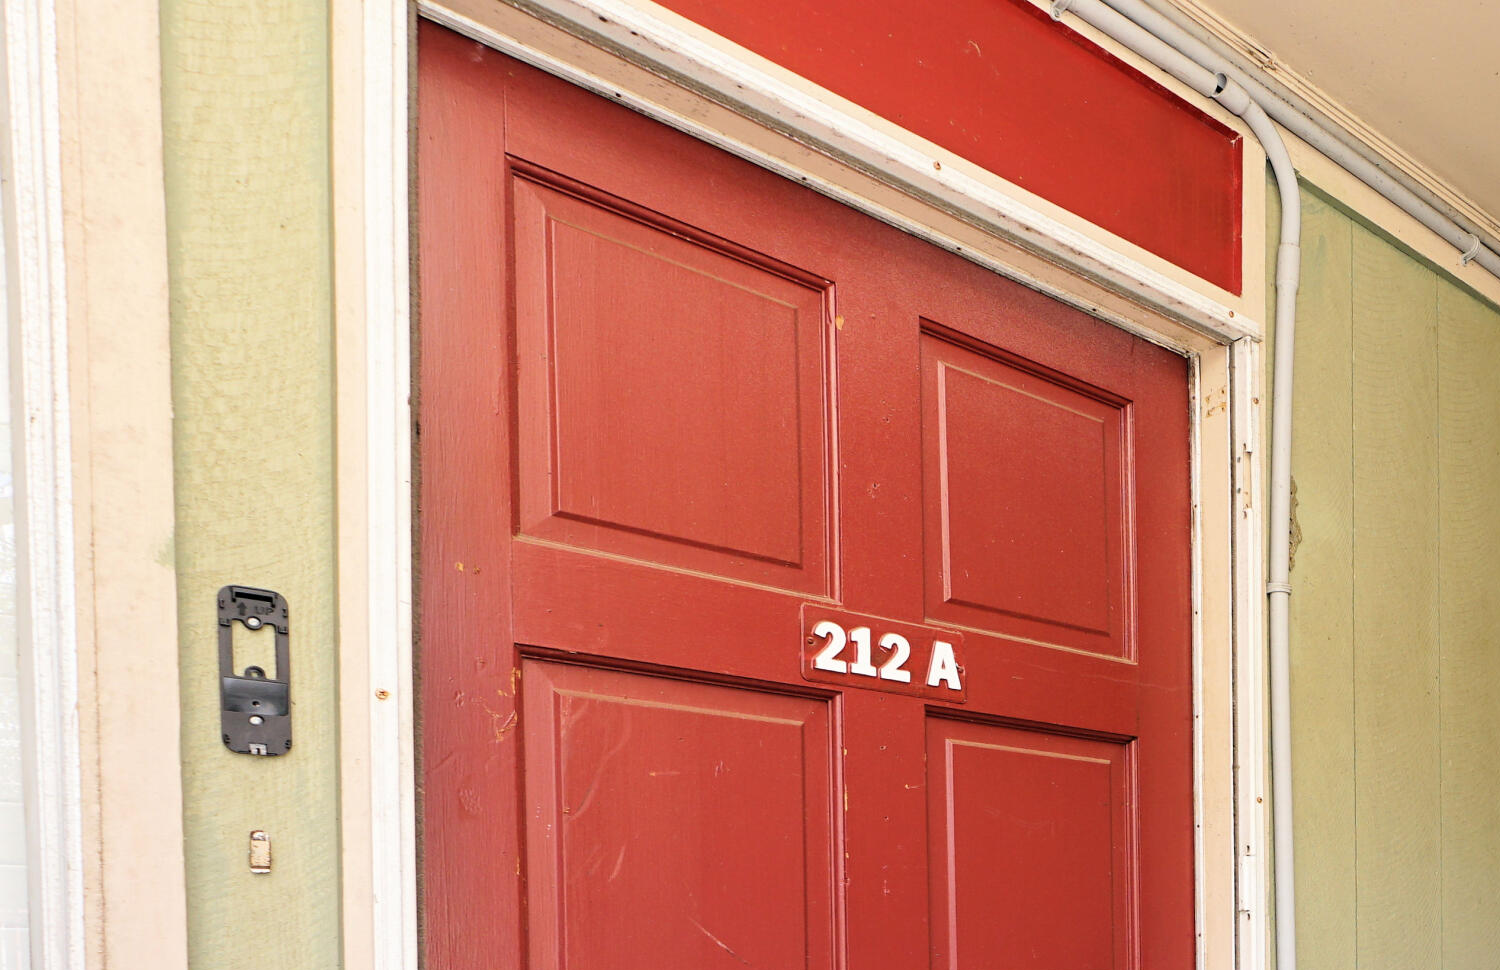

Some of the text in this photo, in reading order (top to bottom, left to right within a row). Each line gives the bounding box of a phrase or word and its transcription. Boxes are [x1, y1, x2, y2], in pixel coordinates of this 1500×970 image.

[254, 606, 274, 616] UP
[812, 620, 962, 691] 212 A
